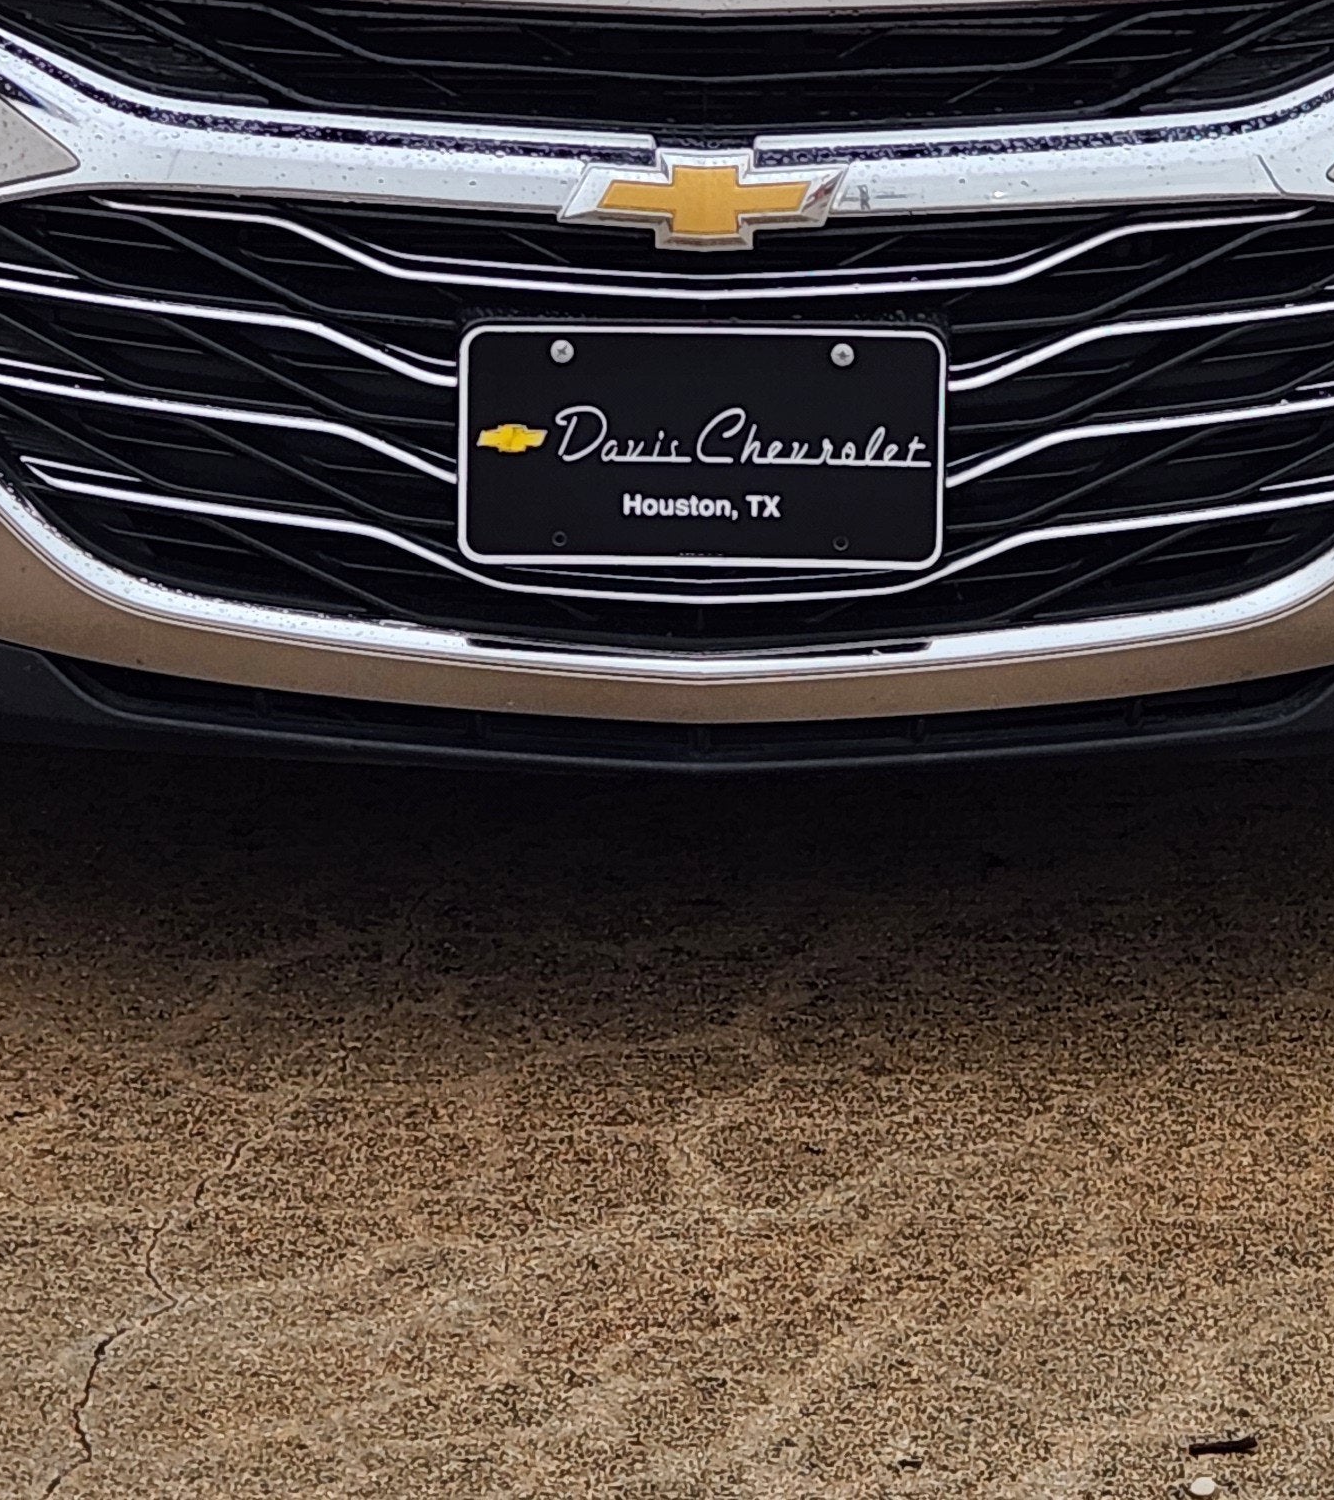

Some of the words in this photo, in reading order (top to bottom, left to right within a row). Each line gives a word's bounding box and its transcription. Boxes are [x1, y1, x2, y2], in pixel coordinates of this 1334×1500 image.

[555, 404, 692, 463] Davis
[696, 407, 932, 469] Chevrolet
[622, 492, 739, 521] Houston,
[745, 494, 782, 519] TX
